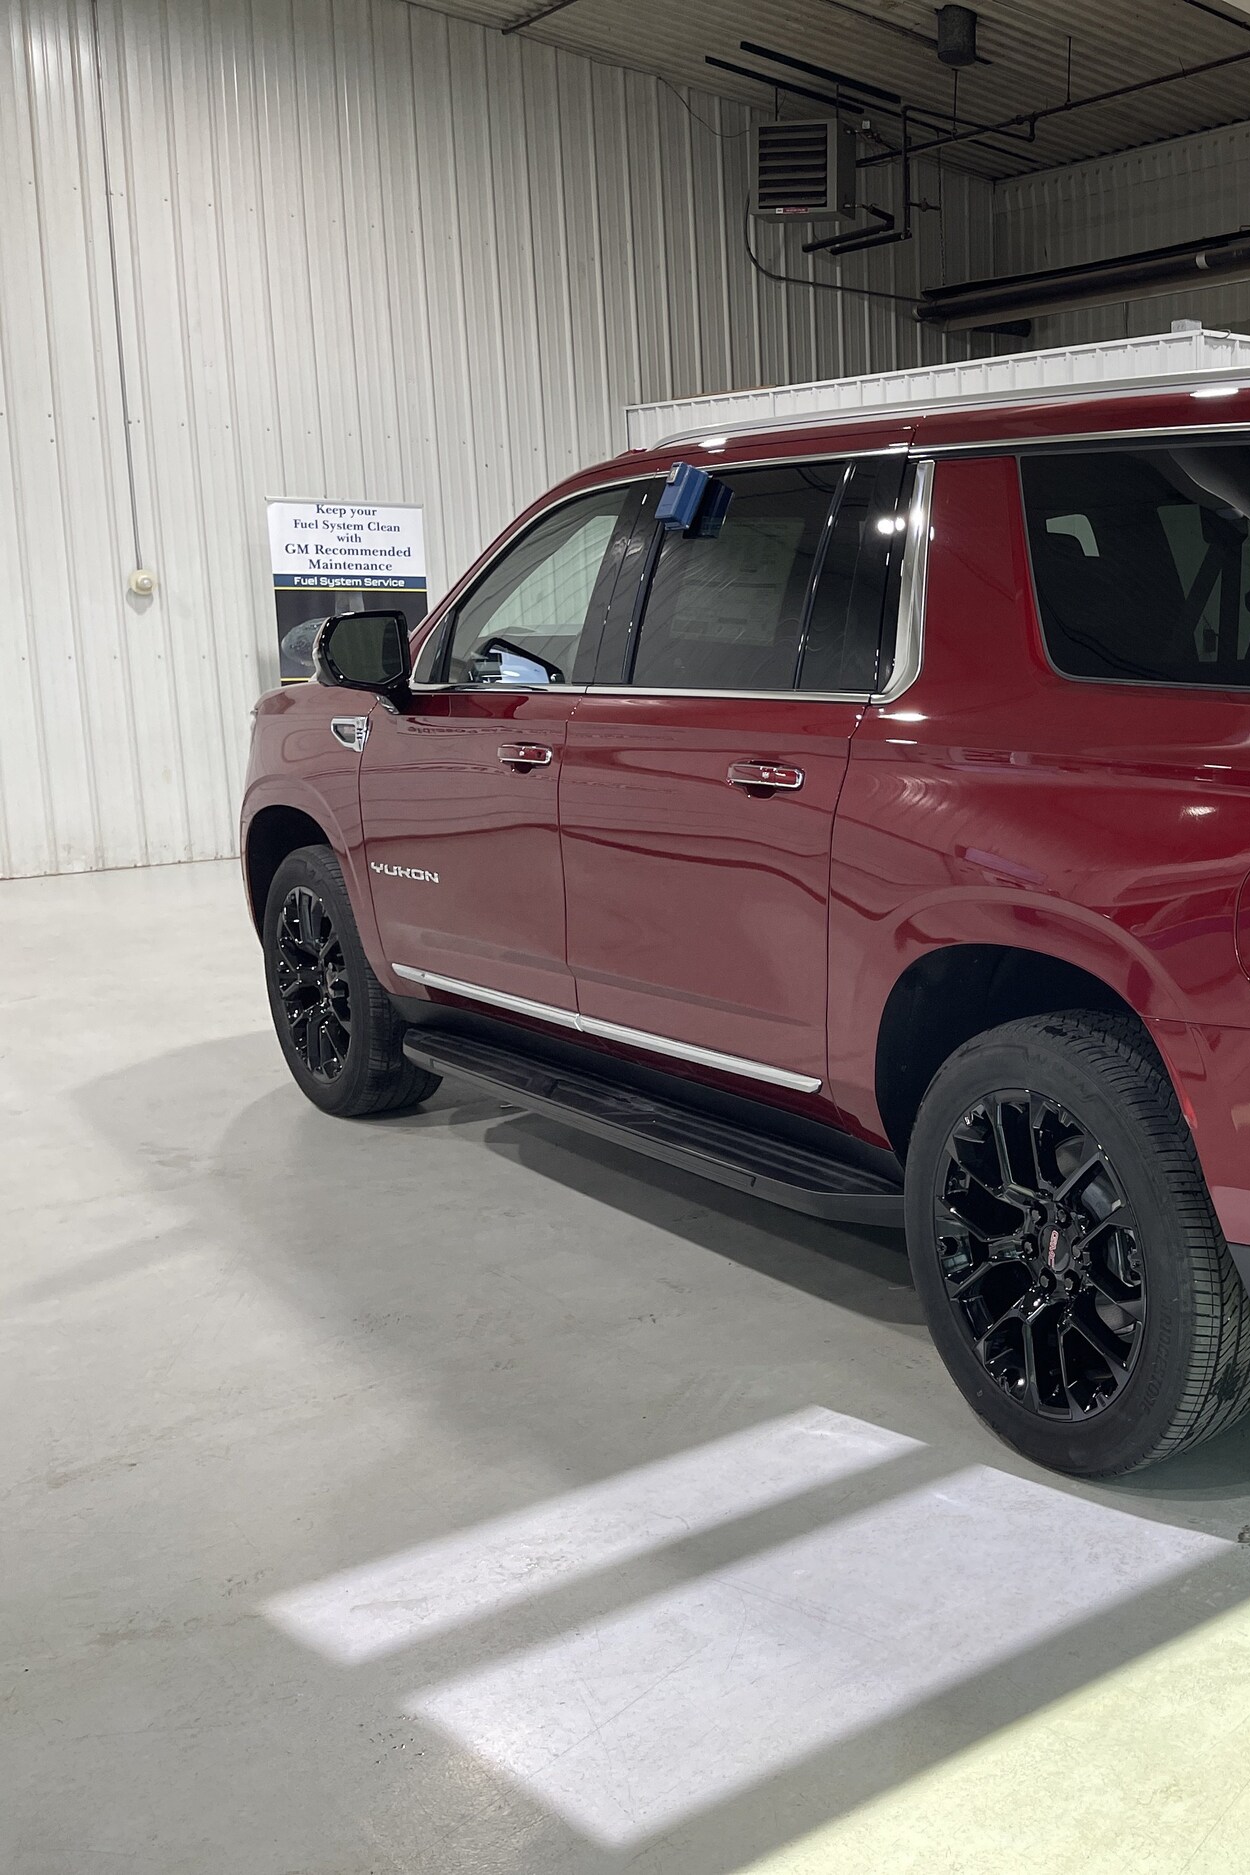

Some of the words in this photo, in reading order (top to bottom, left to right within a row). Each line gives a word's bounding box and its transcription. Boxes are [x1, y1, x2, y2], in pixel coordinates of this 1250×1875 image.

[316, 504, 347, 518] Keep
[350, 507, 378, 519] your
[294, 519, 319, 529] Fuel
[322, 520, 364, 533] System
[367, 521, 401, 532] Clean
[336, 533, 362, 543] with
[284, 543, 310, 555] GM
[314, 545, 411, 557] Recommended
[308, 559, 393, 571] Maintenance
[294, 576, 318, 586] Fuel
[320, 577, 362, 588] System
[364, 578, 405, 587] Service
[370, 861, 439, 884] YUKON
